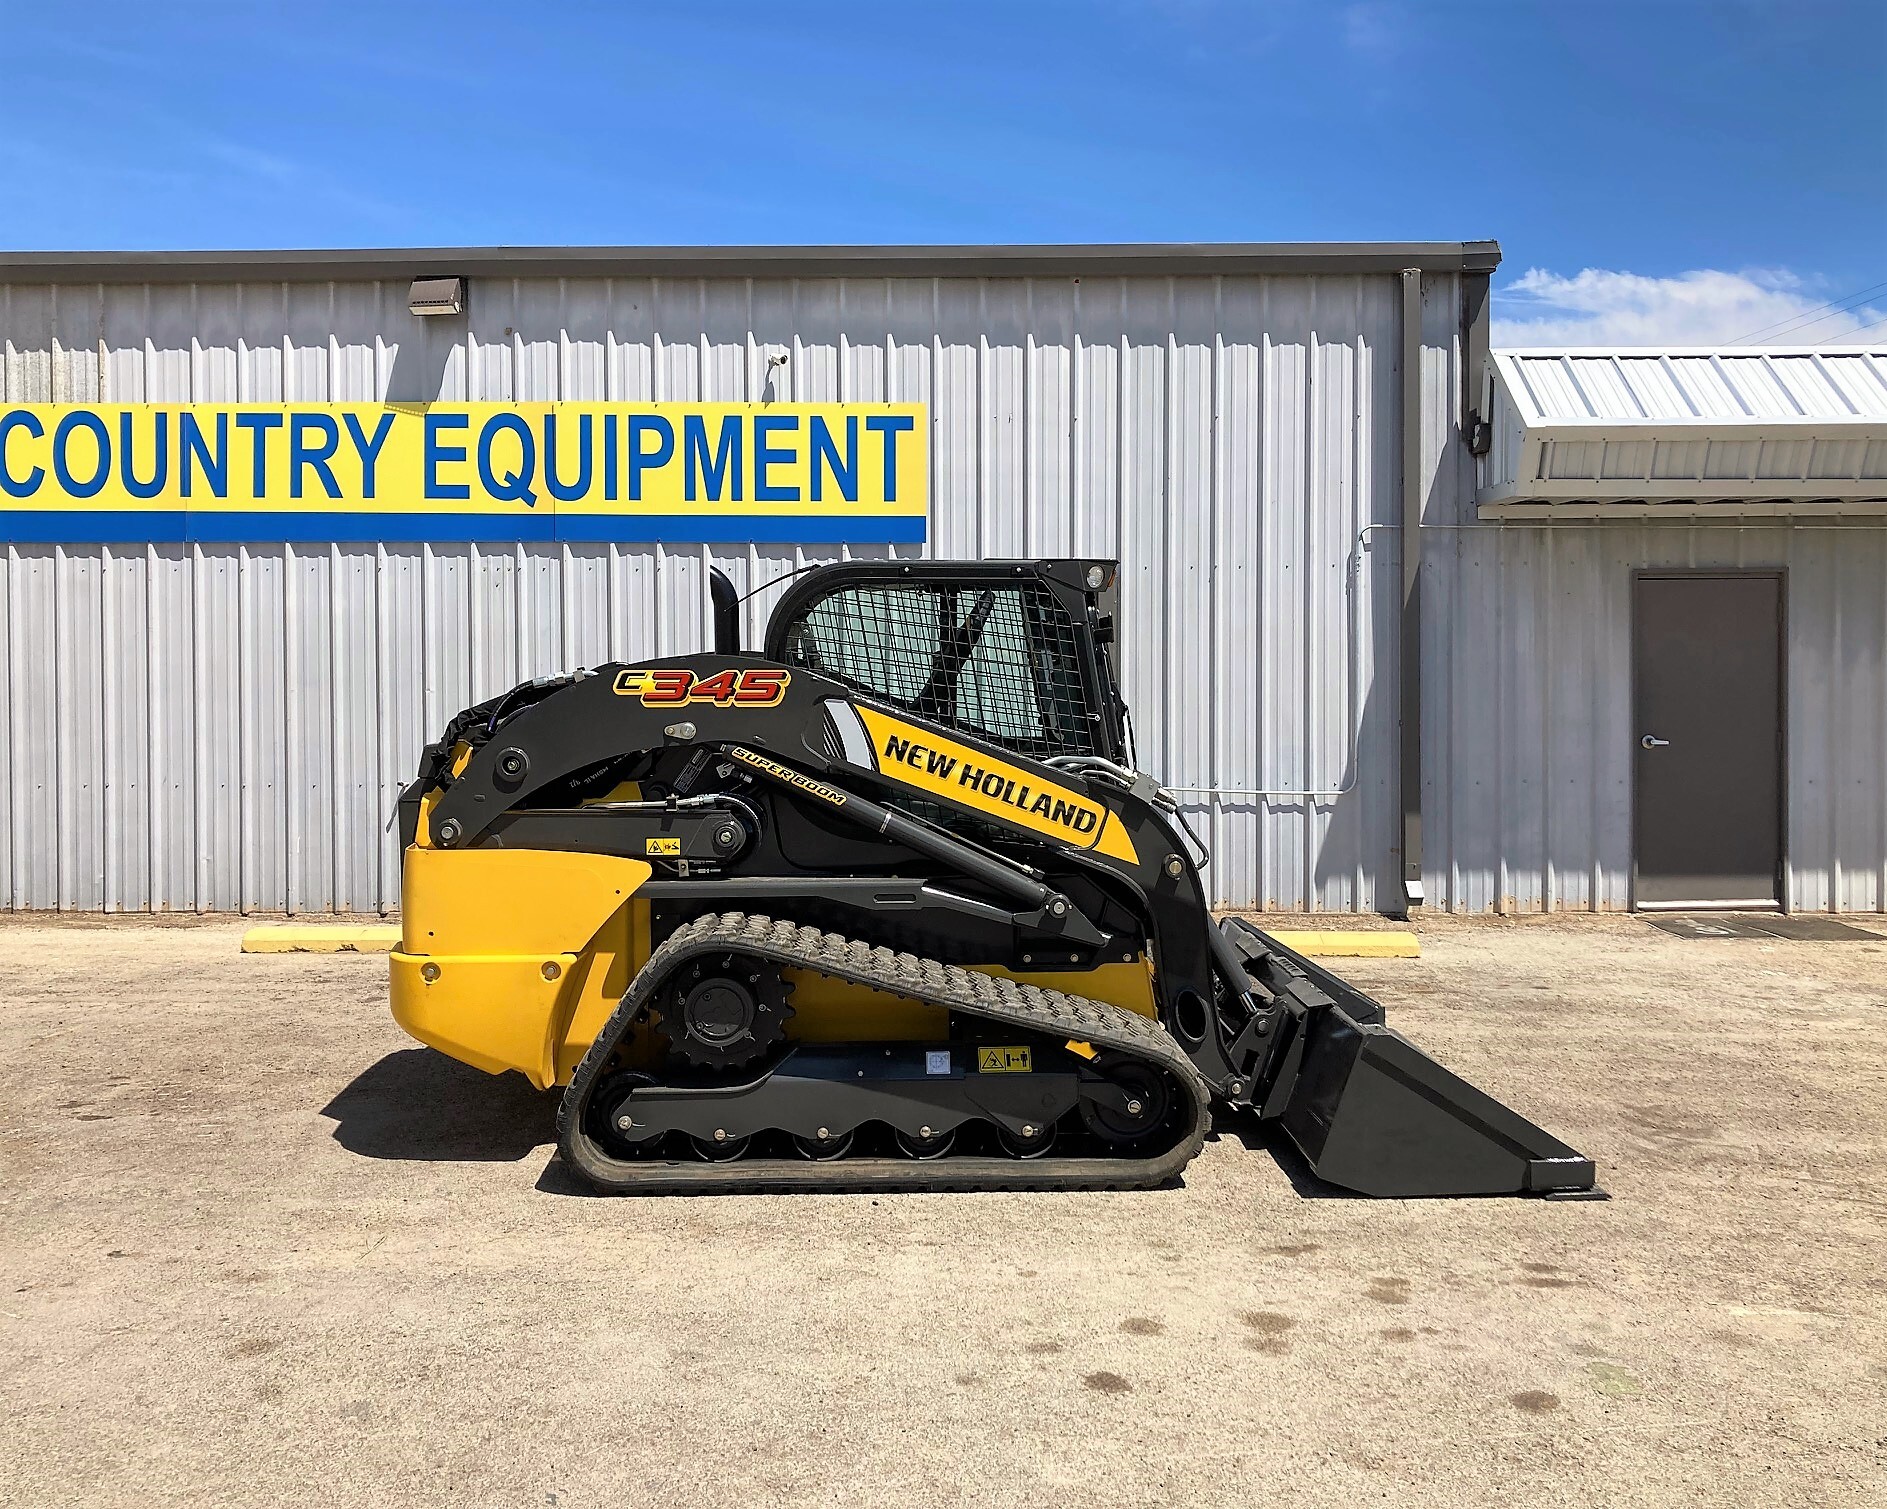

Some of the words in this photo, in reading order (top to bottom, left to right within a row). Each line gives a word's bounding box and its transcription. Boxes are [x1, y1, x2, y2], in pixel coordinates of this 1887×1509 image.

[0, 410, 396, 498] COUNTRY
[424, 413, 915, 507] EQUIPMENT
[885, 735, 957, 779] NEW
[958, 764, 1097, 833] HOLLAND
